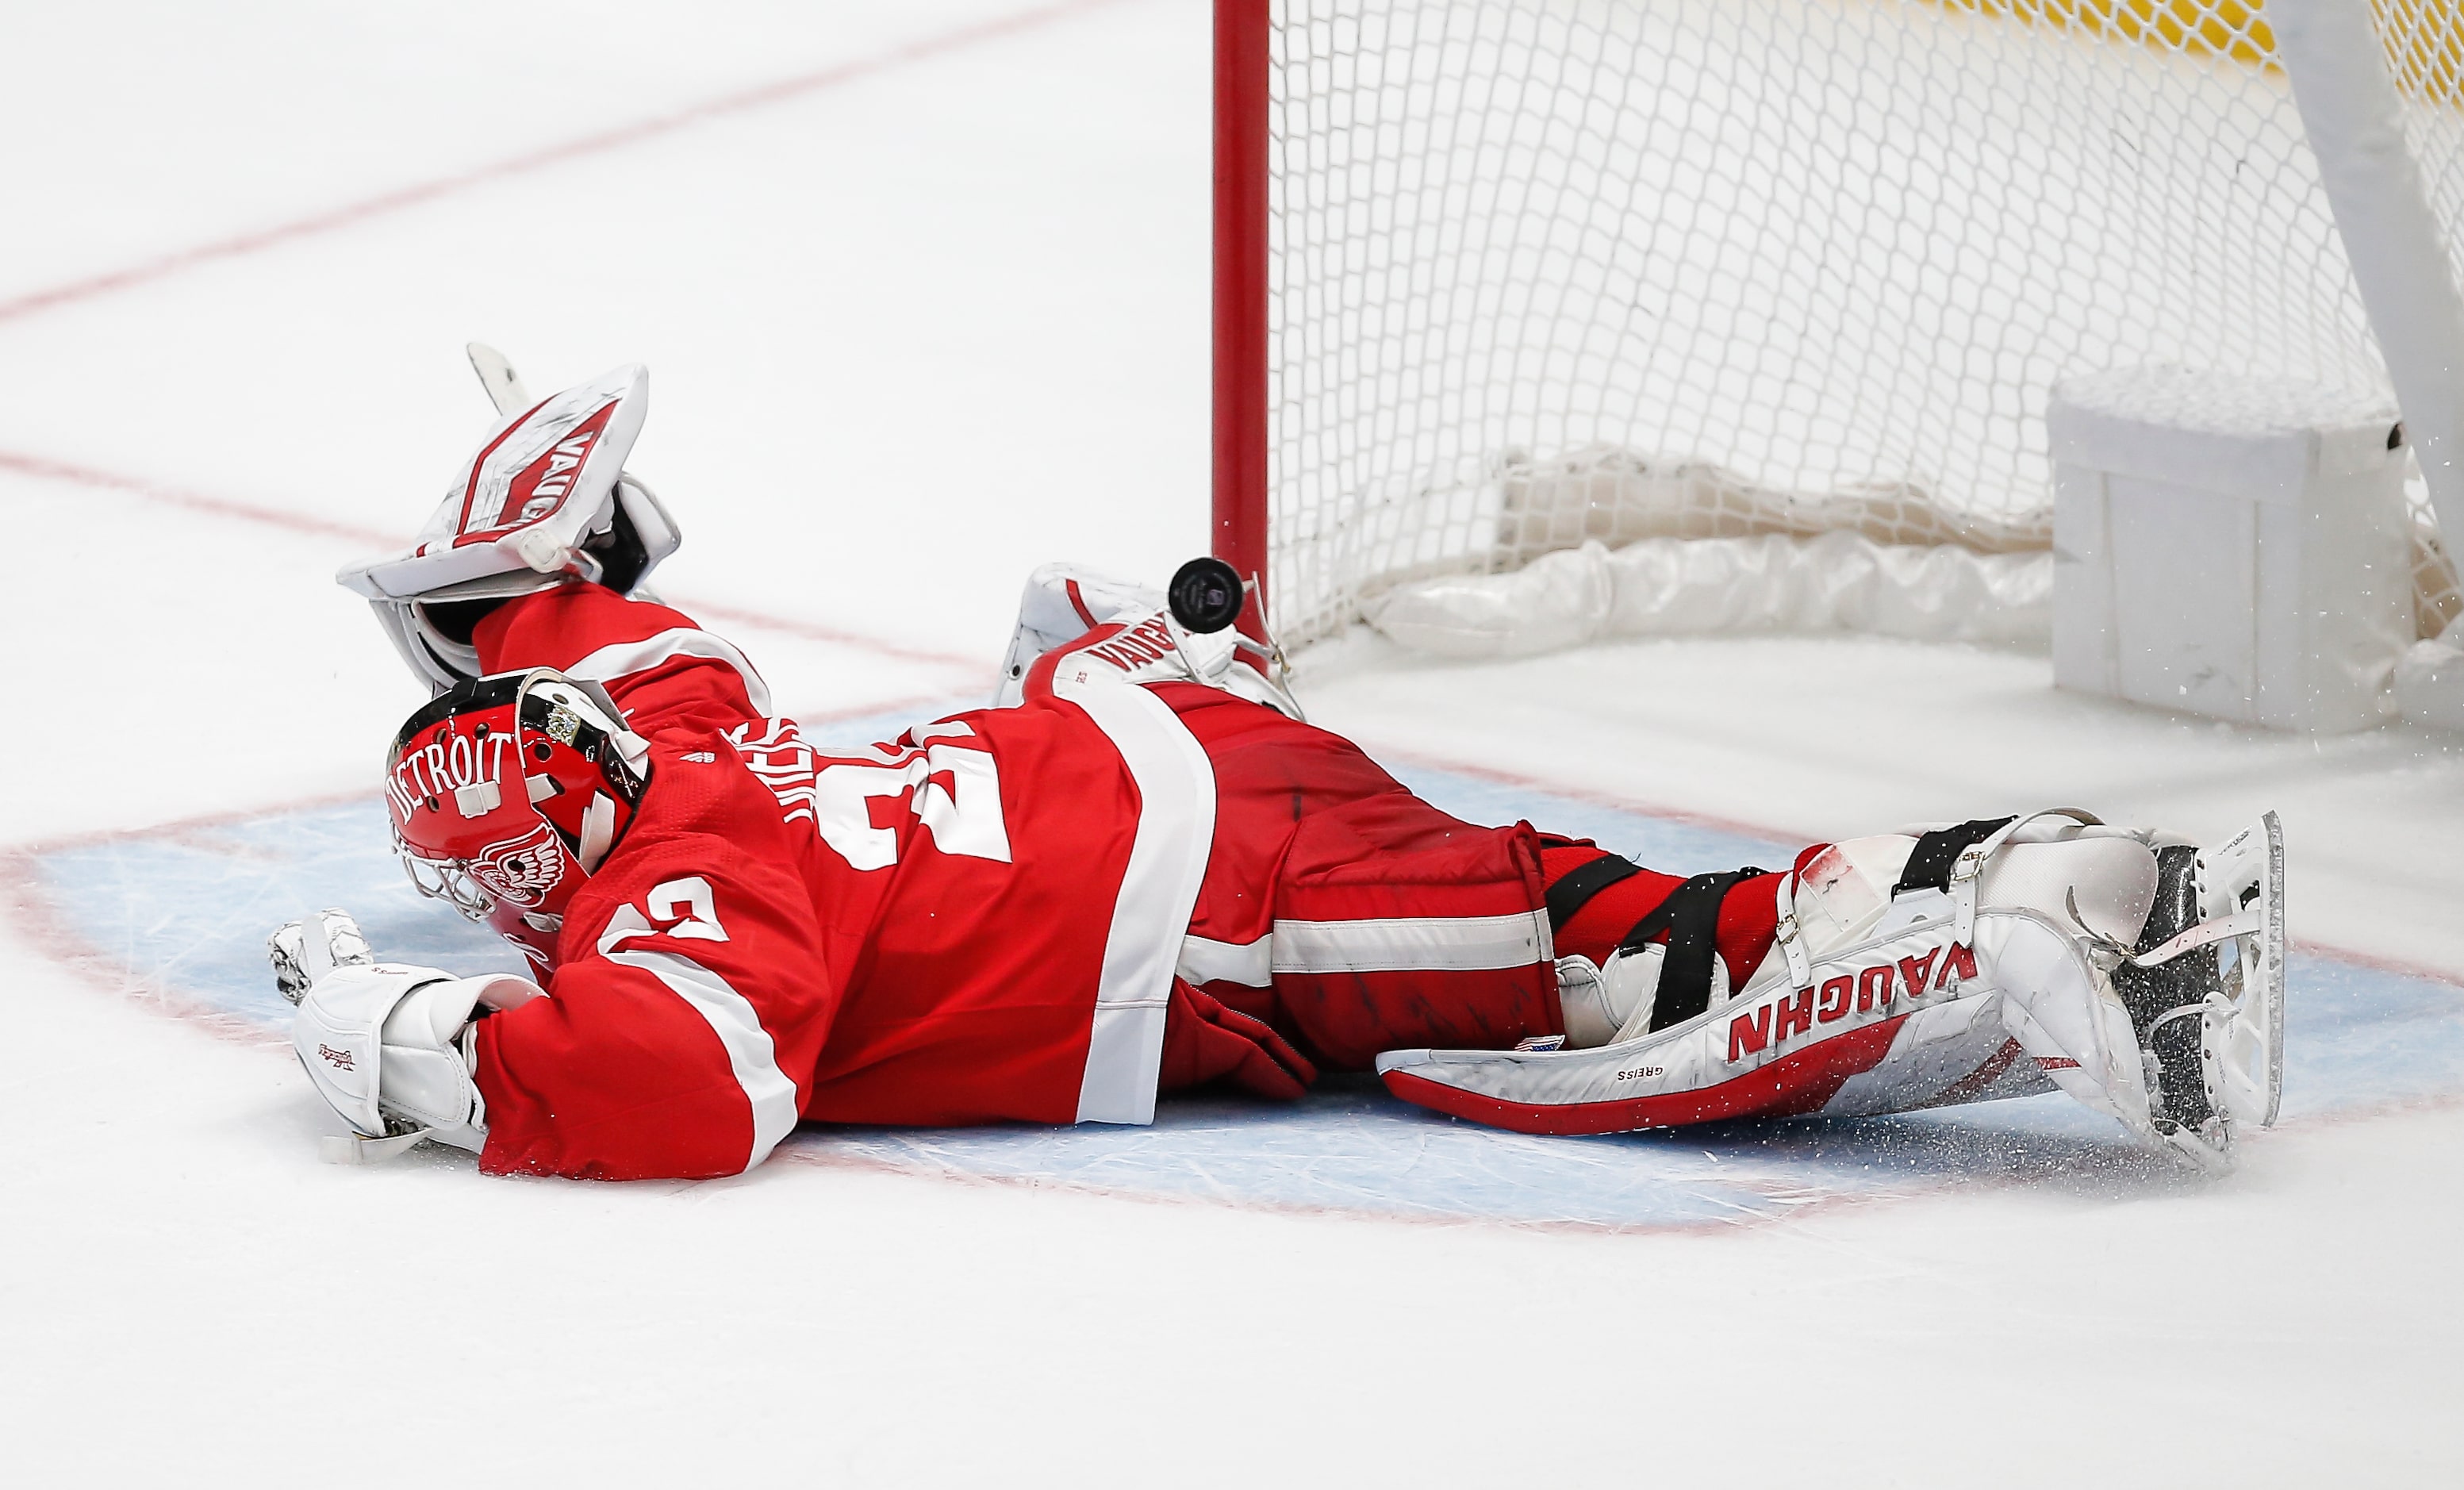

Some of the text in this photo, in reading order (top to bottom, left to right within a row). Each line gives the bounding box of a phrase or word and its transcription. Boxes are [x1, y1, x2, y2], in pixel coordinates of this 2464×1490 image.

[519, 430, 593, 521] VAUG
[385, 732, 512, 826] DETROIT
[1727, 941, 1978, 1064] VAUGHN
[1618, 1066, 1664, 1081] GREISS
